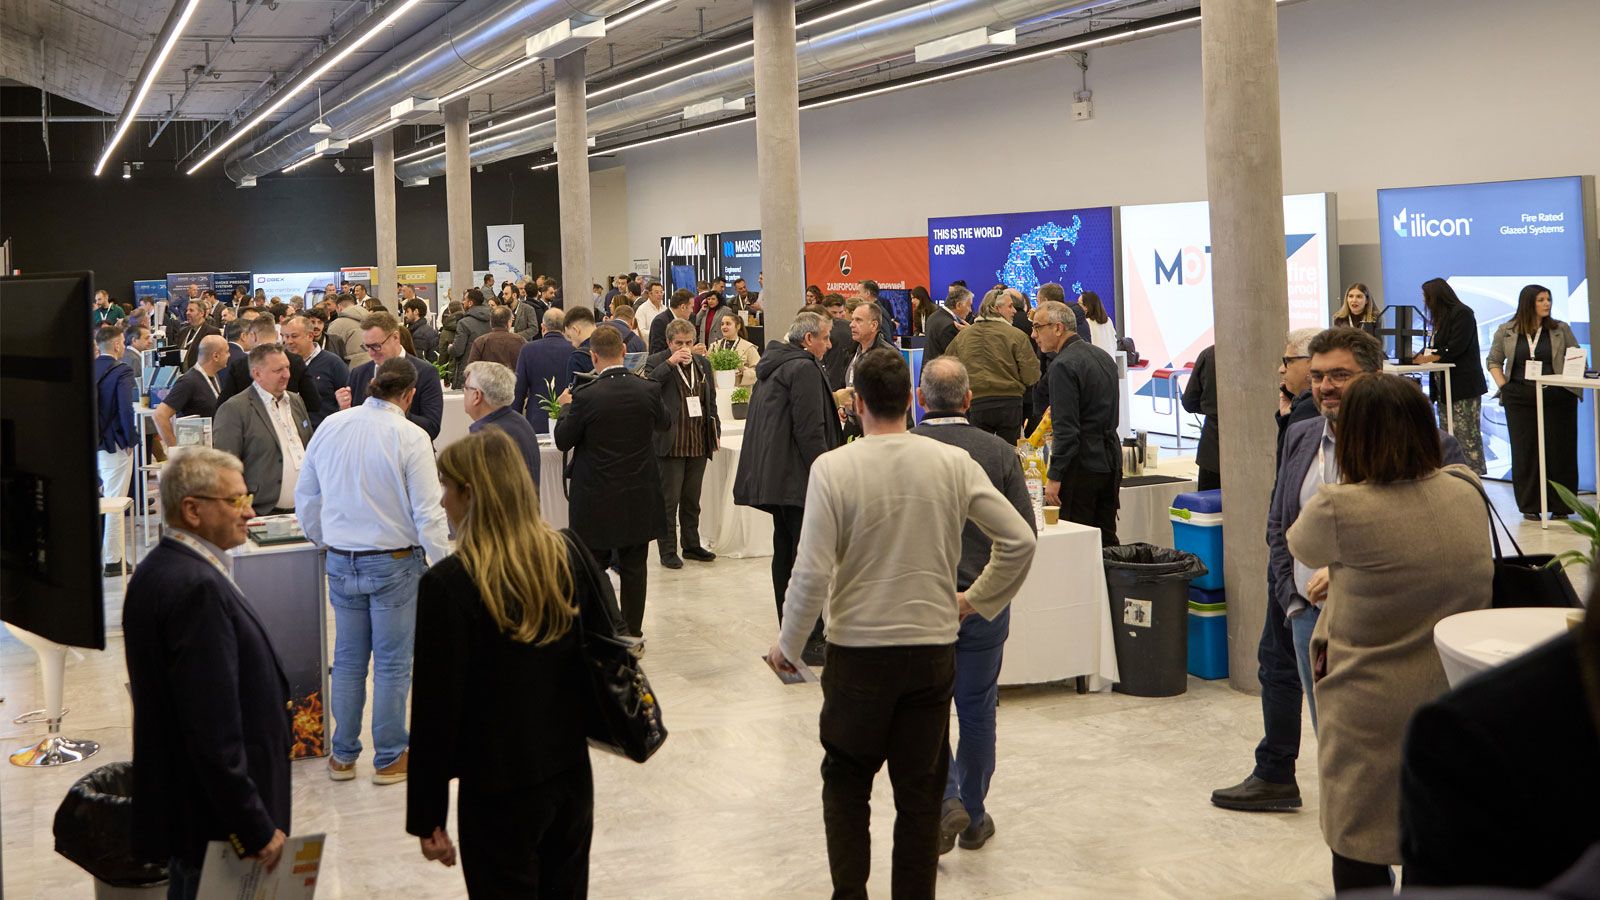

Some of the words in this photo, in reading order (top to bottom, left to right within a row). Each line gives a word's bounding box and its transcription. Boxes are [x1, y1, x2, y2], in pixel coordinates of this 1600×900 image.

[1521, 213, 1537, 222] Fire
[1538, 212, 1563, 222] Rated
[1410, 213, 1470, 238] ilicon
[1500, 225, 1528, 235] Glazed
[1529, 224, 1565, 236] Systems
[933, 229, 950, 240] THIS
[950, 228, 958, 239] IS
[958, 228, 973, 239] THE
[974, 226, 1003, 238] WORLD
[735, 239, 760, 253] MAKRIS
[934, 245, 945, 255] OF
[945, 244, 966, 255] IFSAS
[826, 282, 859, 291] ZARIFOPOUL
